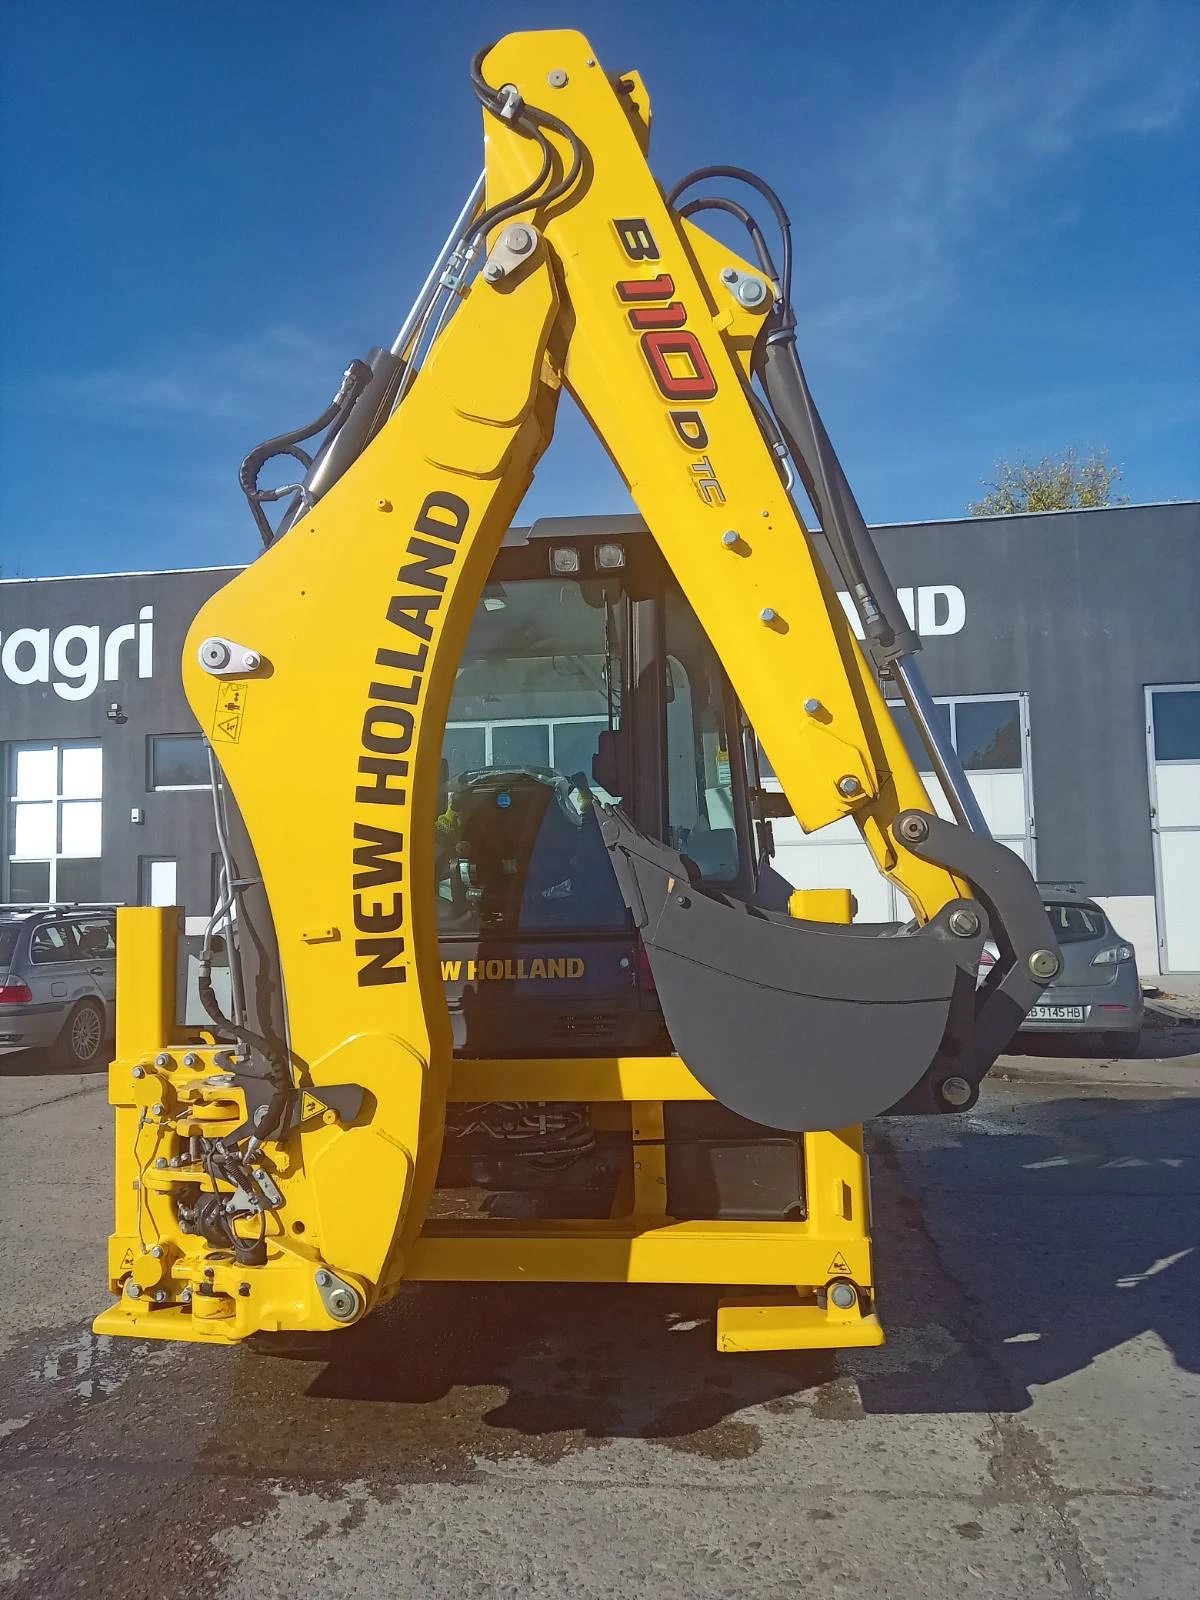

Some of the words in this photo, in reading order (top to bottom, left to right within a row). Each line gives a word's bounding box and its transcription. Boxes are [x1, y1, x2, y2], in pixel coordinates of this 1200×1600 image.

[0, 605, 153, 701] agri
[355, 490, 470, 806] HOLLAND
[352, 822, 407, 988] NEW
[467, 957, 585, 981] HOLLAND
[1039, 1007, 1065, 1017] 9145
[1067, 1007, 1081, 1018] HB
